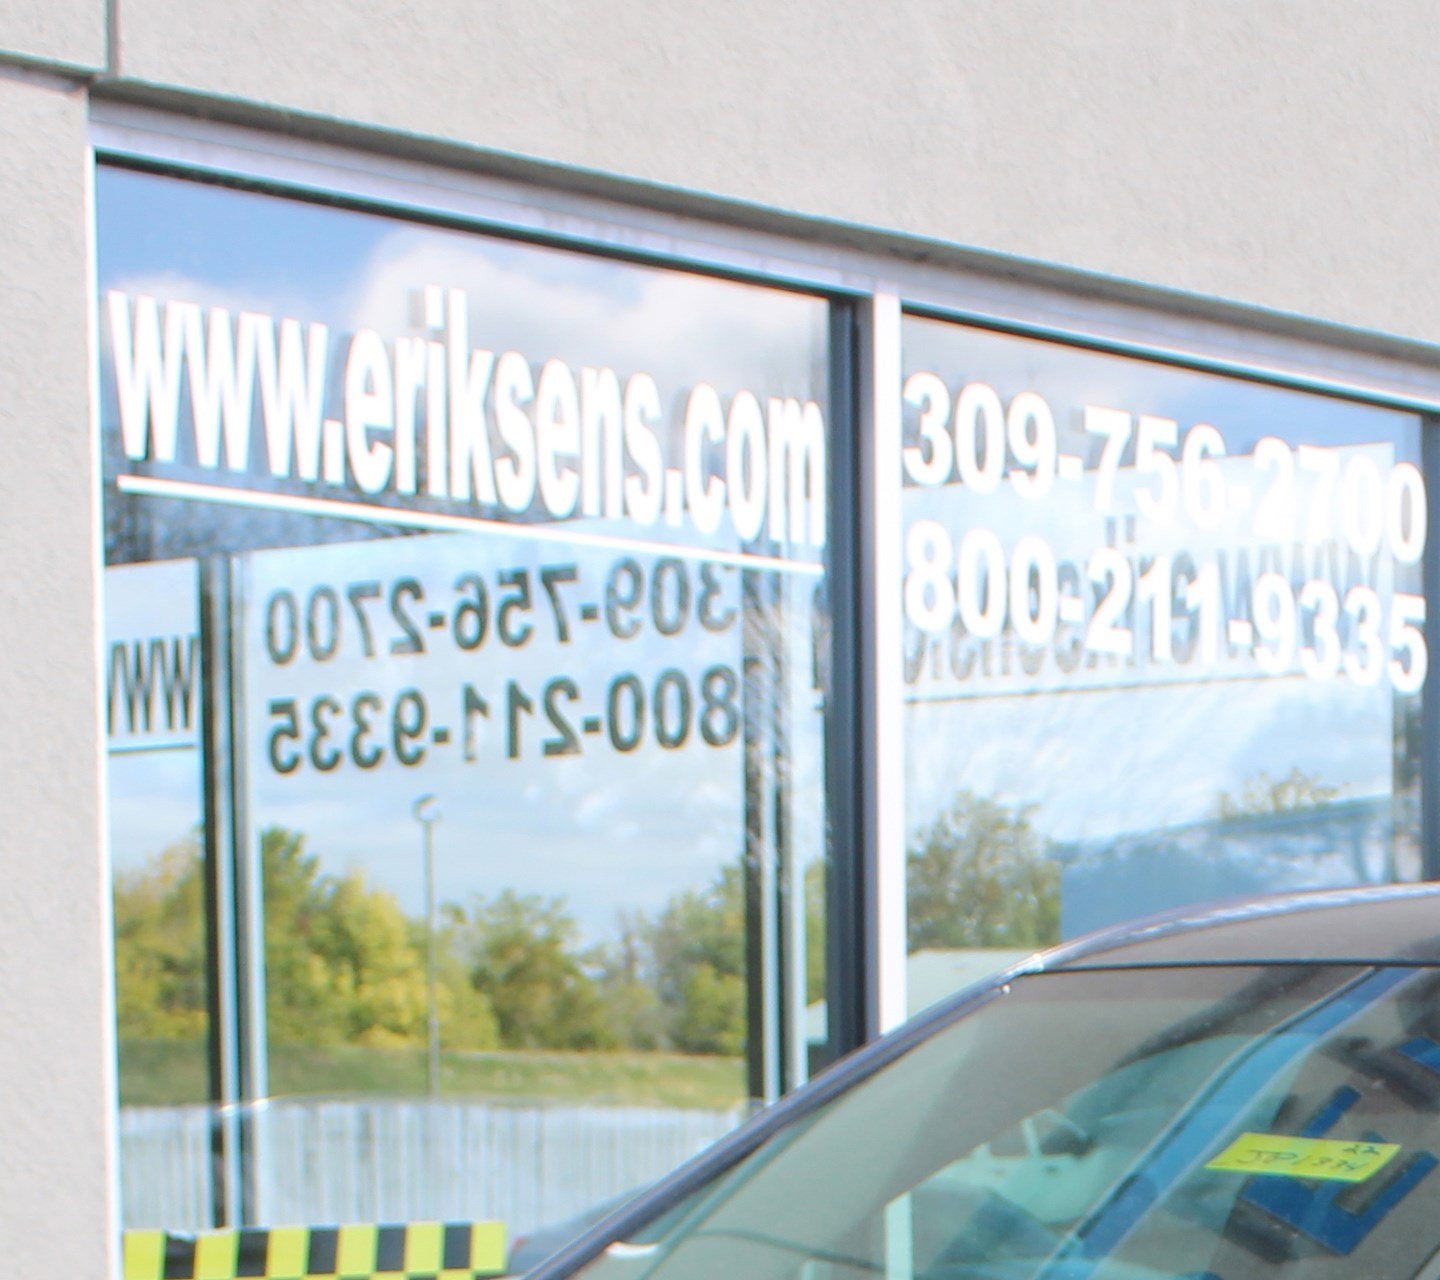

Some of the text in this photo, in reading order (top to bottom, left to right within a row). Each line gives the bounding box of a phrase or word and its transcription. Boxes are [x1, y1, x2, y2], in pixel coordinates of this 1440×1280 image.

[107, 285, 826, 548] www.eriksens.com
[901, 372, 1428, 565] 309-756-2700
[902, 519, 1428, 693] 800-211-9335
